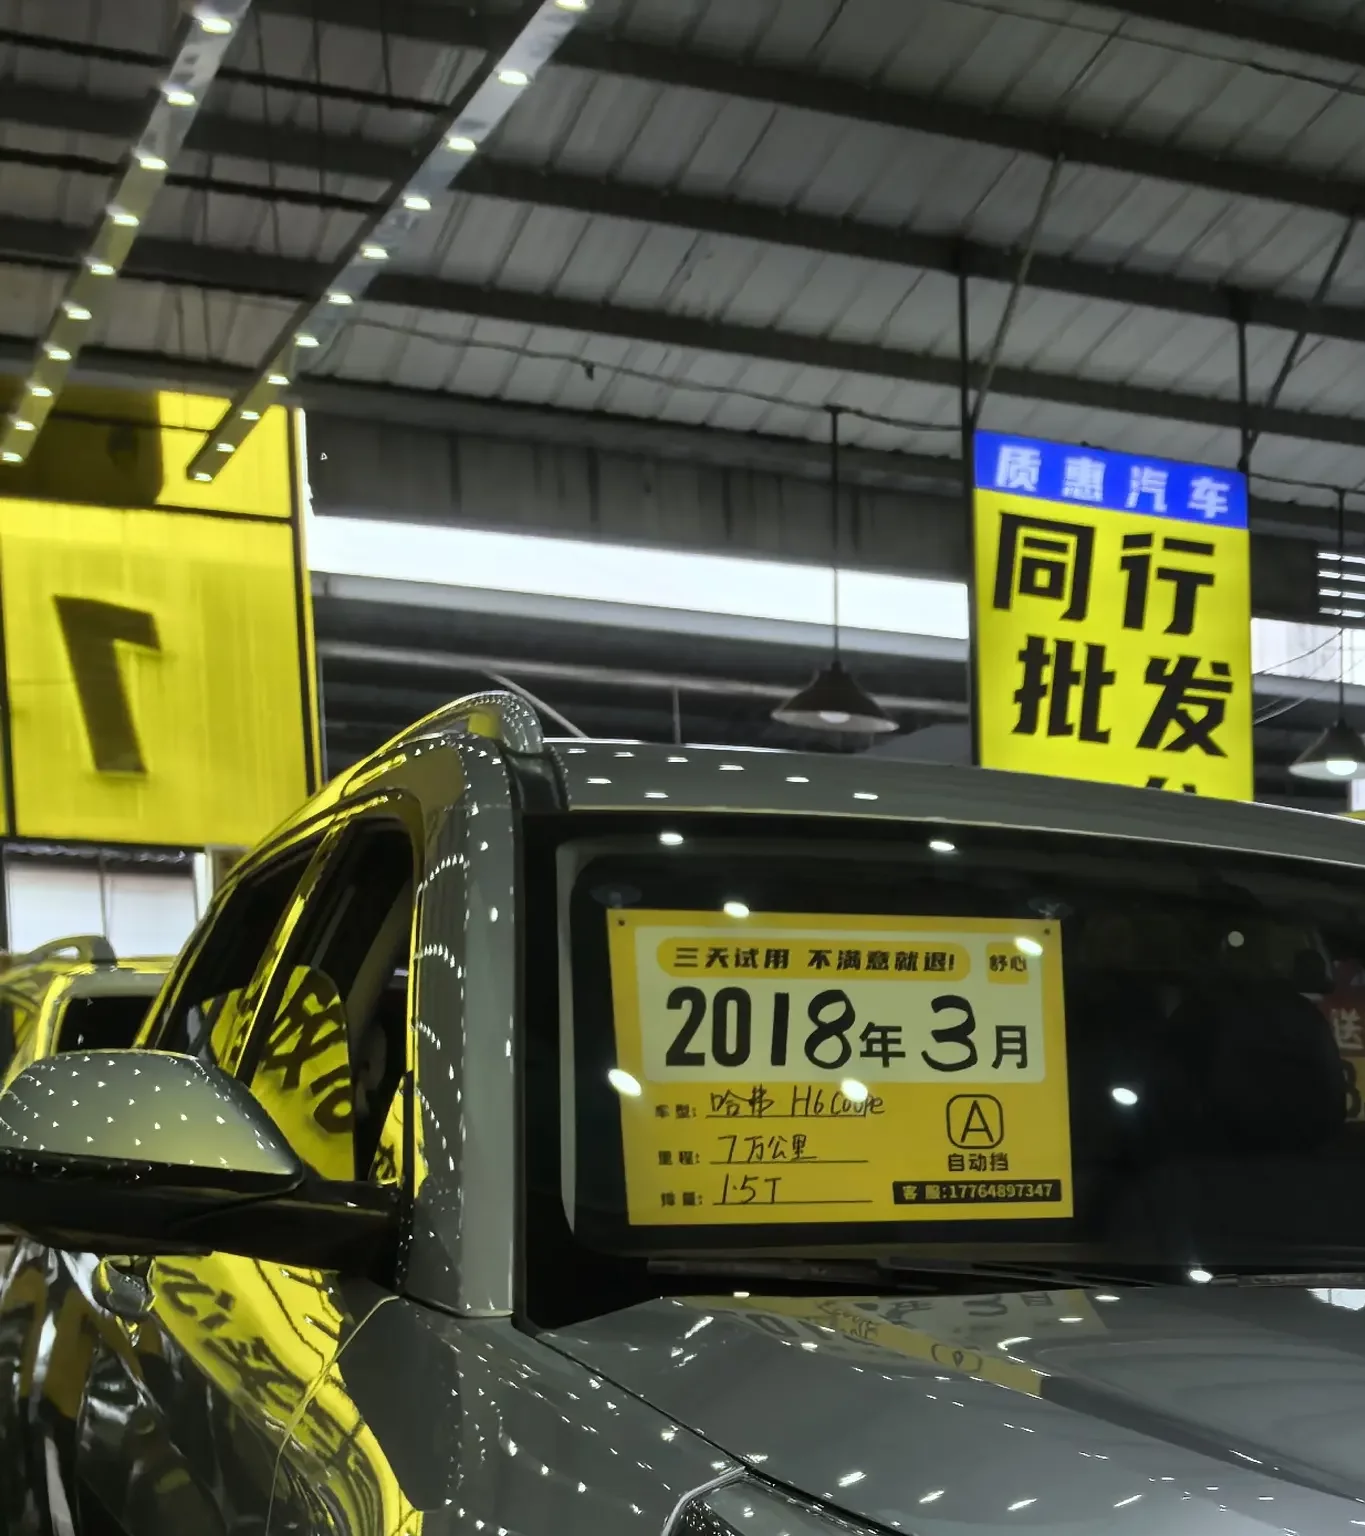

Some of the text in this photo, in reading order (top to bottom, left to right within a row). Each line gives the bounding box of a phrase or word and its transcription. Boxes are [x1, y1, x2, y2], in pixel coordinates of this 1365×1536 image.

[995, 445, 1230, 519] 质惠汽车
[993, 511, 1215, 636] 同行
[1011, 634, 1234, 758] 批发
[674, 947, 956, 972] 三天试用 不满意就退!
[665, 985, 1028, 1072] 2018年3月
[960, 1100, 994, 1143] A
[948, 1153, 1009, 1172] 自动挡
